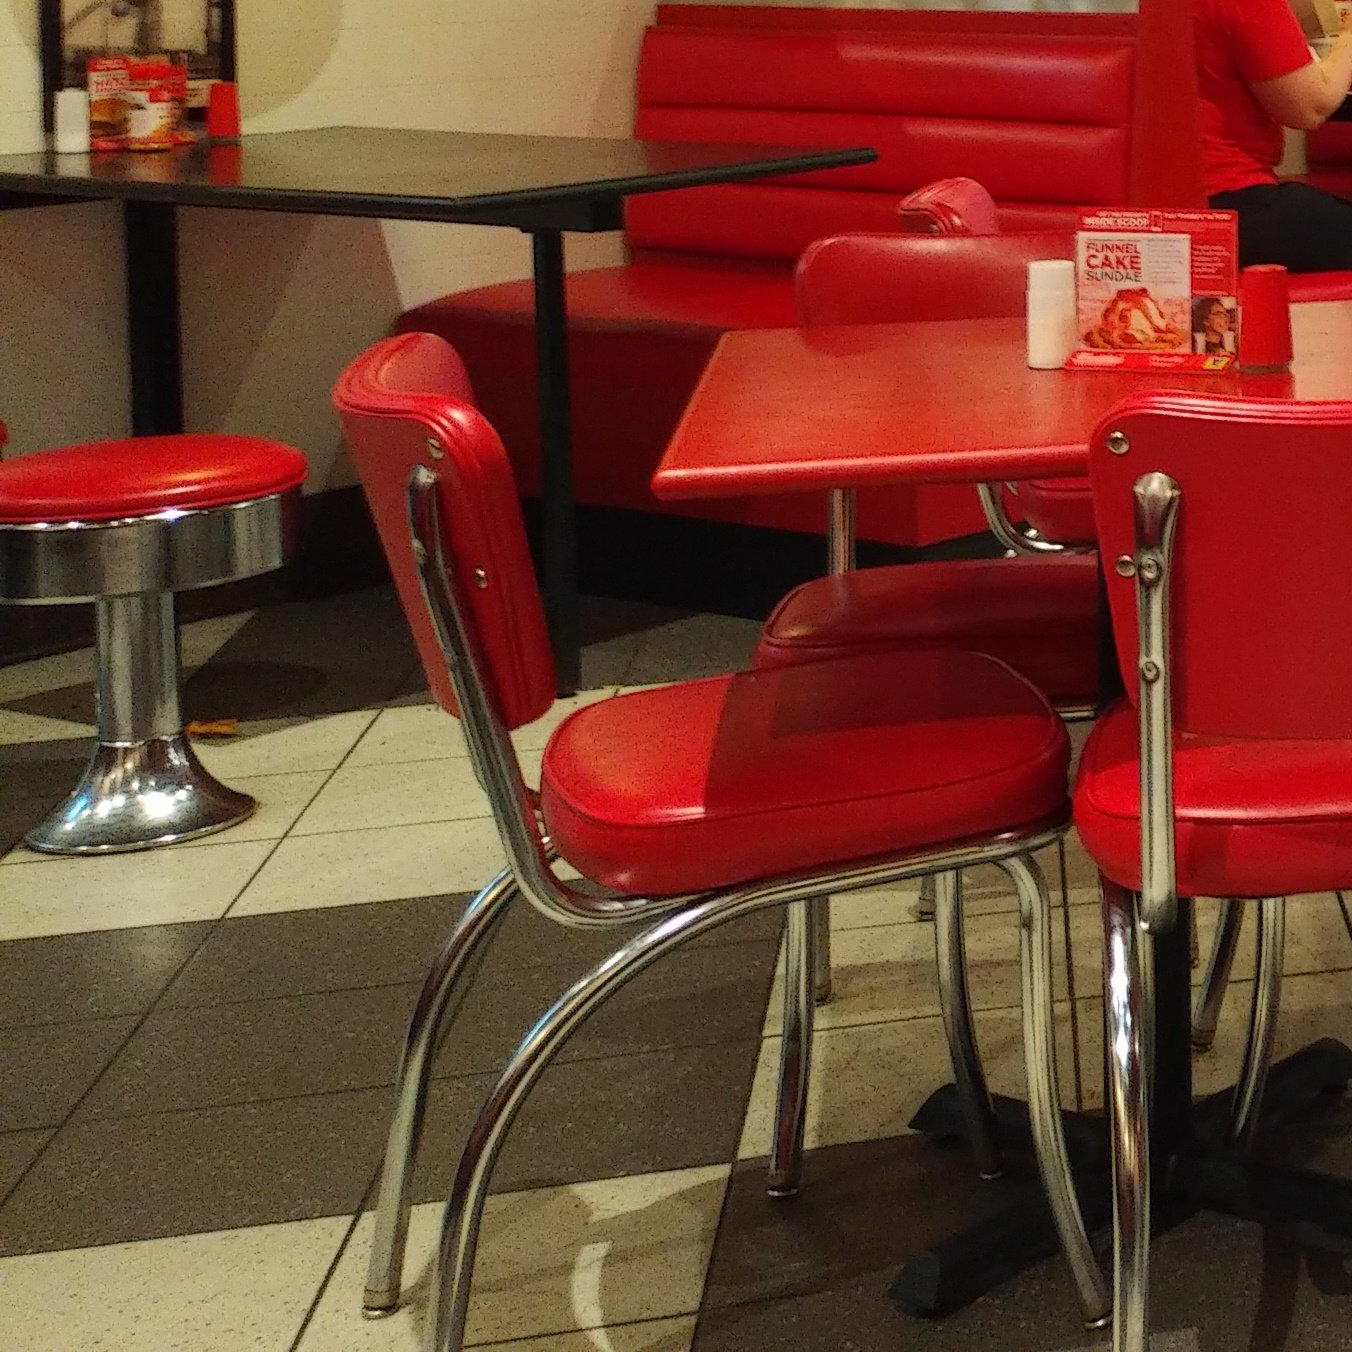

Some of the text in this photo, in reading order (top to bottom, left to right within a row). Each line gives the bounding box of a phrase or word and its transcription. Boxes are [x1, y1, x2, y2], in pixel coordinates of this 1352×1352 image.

[1086, 242, 1141, 255] FUNNEL
[1086, 254, 1142, 270] CAKE
[1085, 270, 1142, 283] SUNDAE
